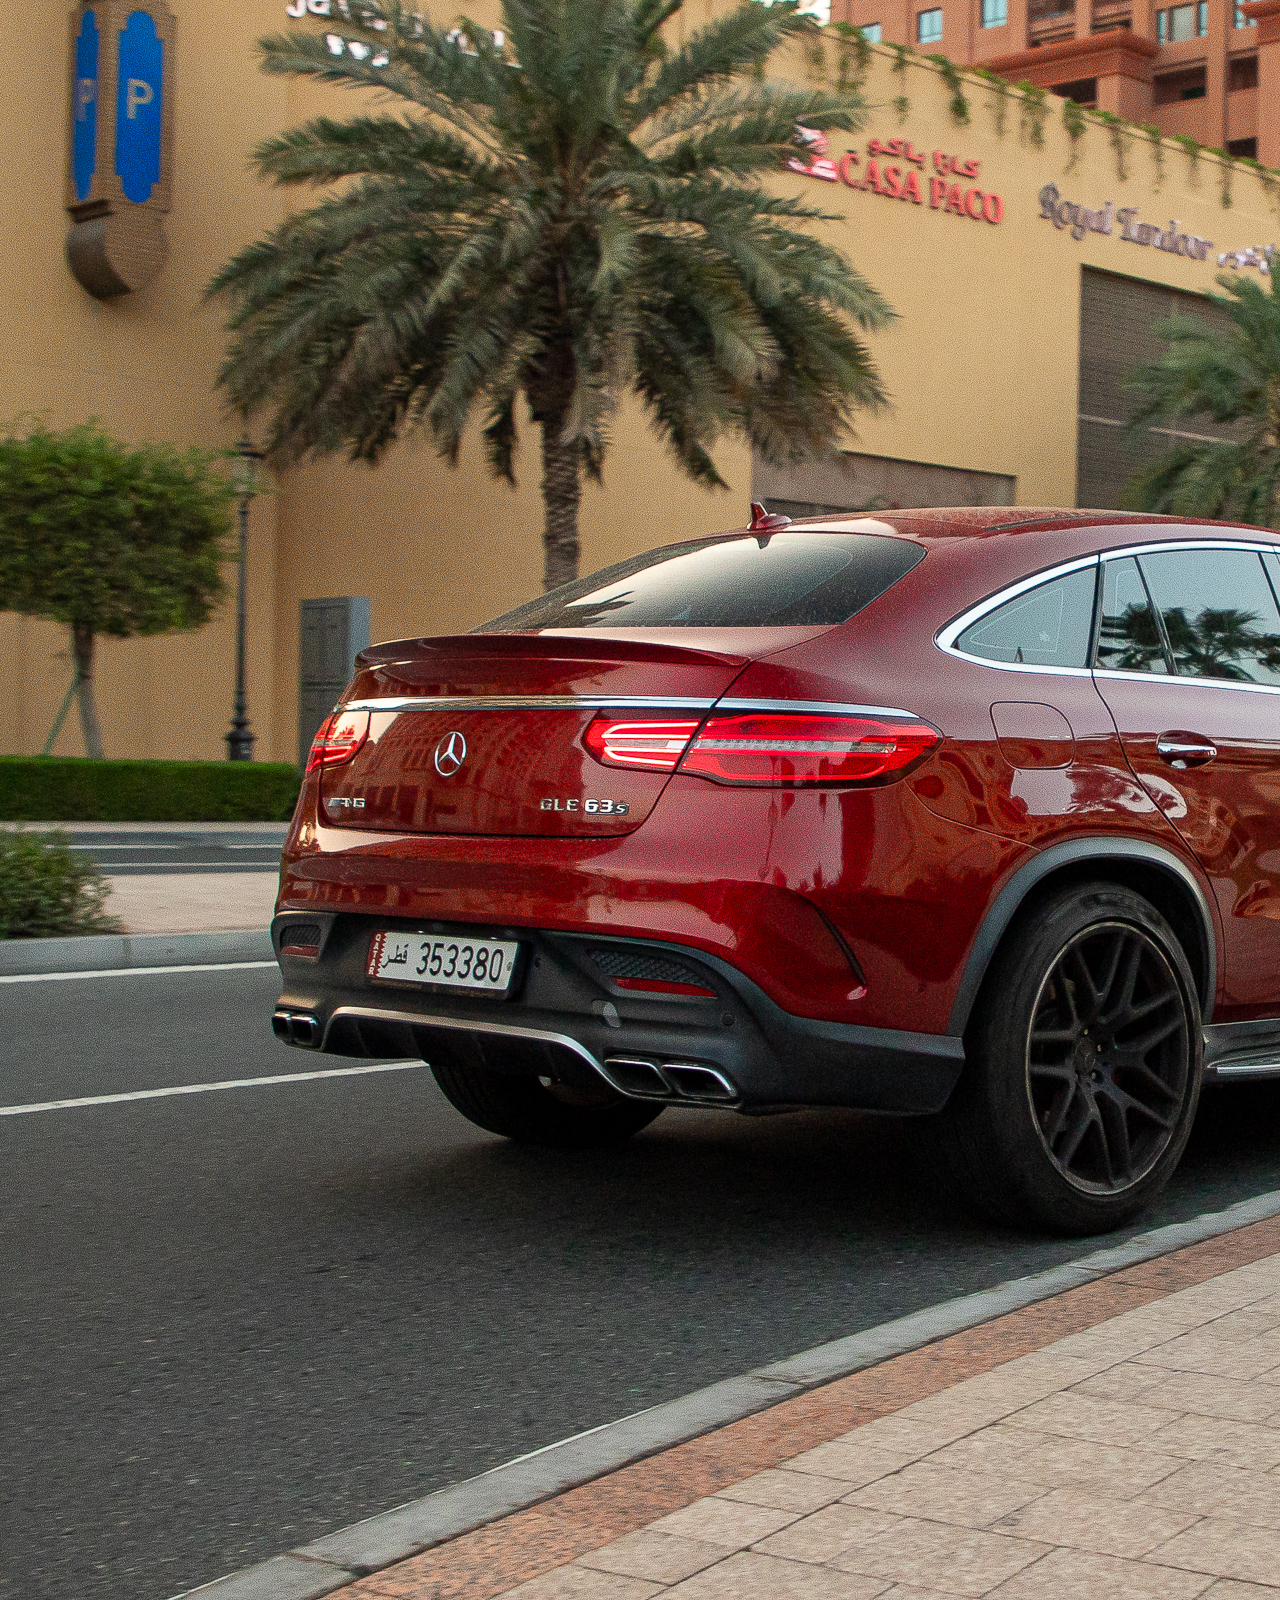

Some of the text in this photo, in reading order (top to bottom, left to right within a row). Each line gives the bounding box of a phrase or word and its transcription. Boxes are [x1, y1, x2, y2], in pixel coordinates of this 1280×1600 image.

[127, 78, 154, 119] P
[840, 153, 1004, 224] CASA PACO
[1038, 181, 1114, 241] Royal
[540, 798, 580, 812] GLE
[368, 932, 382, 976] QATAR
[381, 944, 409, 969] قطر
[416, 942, 504, 983] 353380
